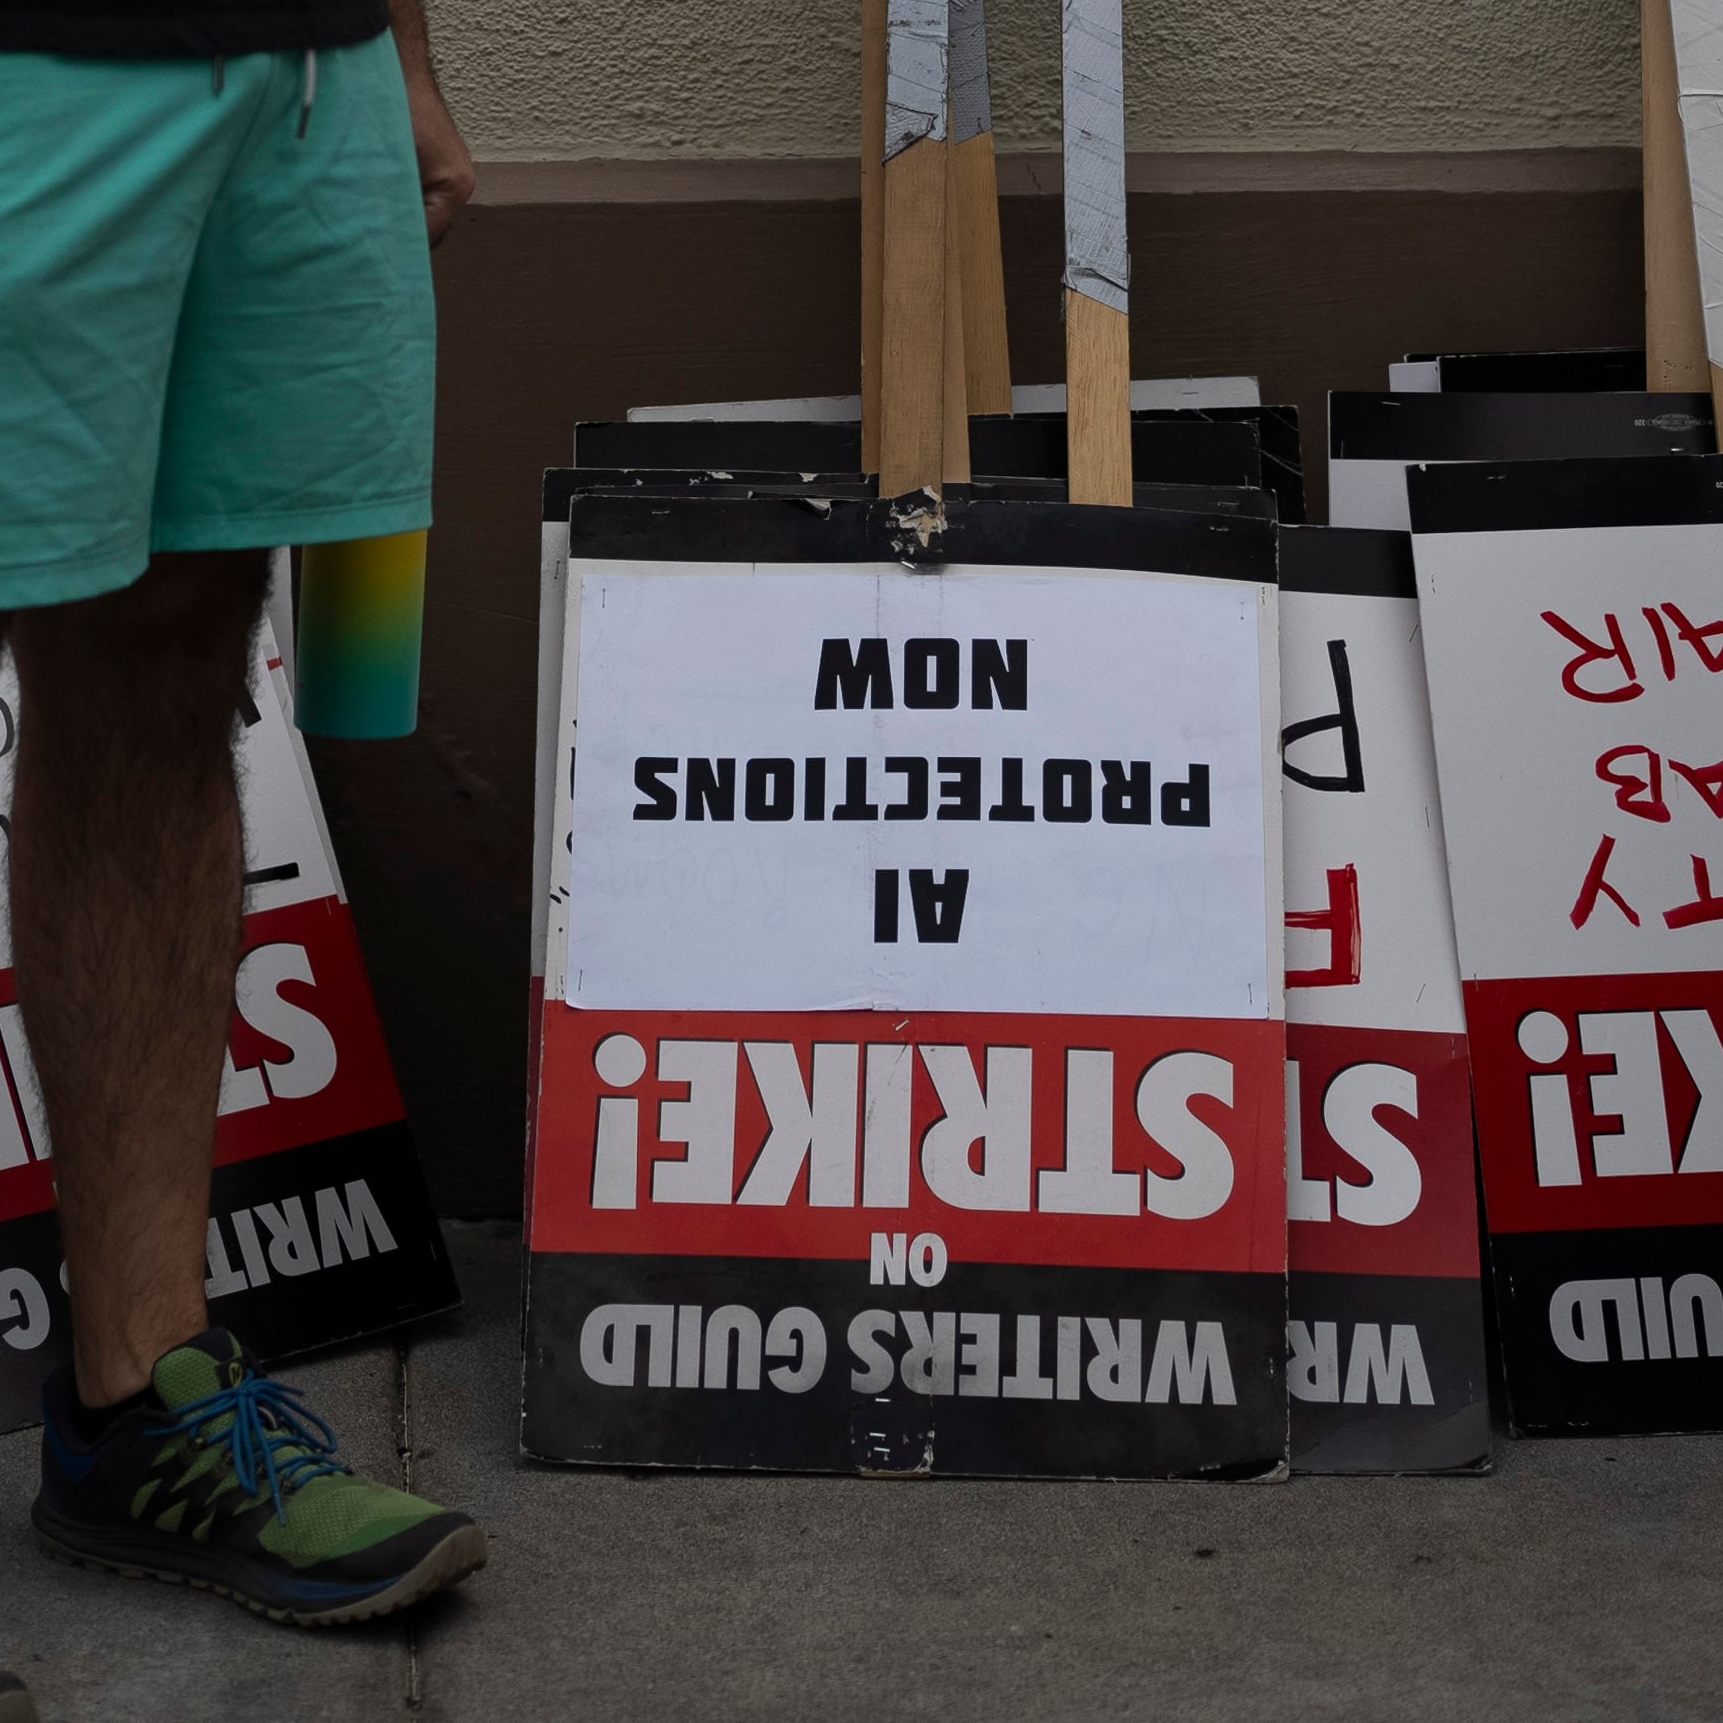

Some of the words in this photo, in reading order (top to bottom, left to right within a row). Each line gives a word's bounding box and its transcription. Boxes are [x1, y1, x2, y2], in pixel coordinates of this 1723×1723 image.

[814, 638, 1029, 712] NOW
[632, 756, 1211, 828] PROTECTIONS
[874, 868, 969, 944] AI
[590, 1032, 1235, 1220] STRIKE!
[870, 1231, 948, 1289] ON
[579, 1303, 828, 1395] GUILD
[846, 1310, 1237, 1406] WRITERS
